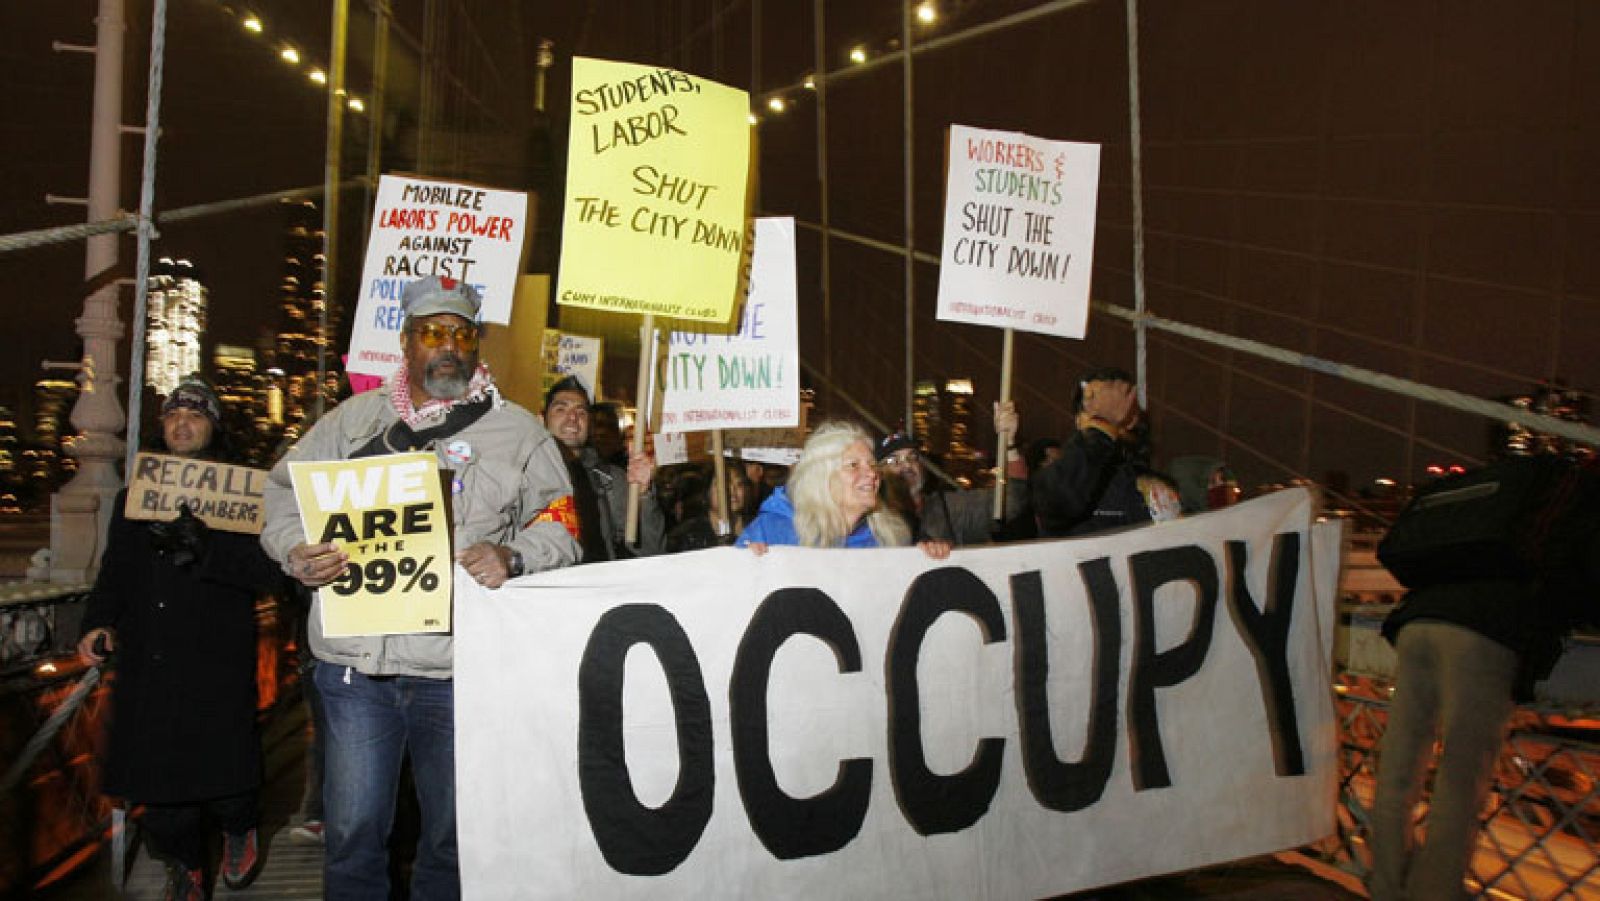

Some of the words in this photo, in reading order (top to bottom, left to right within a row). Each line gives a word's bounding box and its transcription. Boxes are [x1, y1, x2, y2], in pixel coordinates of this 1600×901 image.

[576, 69, 701, 115] STUDENTS,
[593, 104, 687, 154] LABOR
[968, 138, 1044, 171] WORKERS
[402, 184, 486, 211] MOBILIZE
[633, 164, 718, 209] SHUT
[975, 168, 1063, 205] STUDENTS
[379, 208, 440, 231] LABOR'S
[446, 212, 513, 242] POWER
[574, 197, 621, 227] THE
[631, 206, 688, 239] CITY
[692, 219, 743, 252] DOWN
[962, 202, 1013, 238] SHUT
[1025, 212, 1054, 244] THE
[399, 236, 473, 256] AGAINST
[954, 238, 999, 268] CITY
[1008, 246, 1071, 283] DOWN!
[383, 255, 476, 283] RACIST
[562, 290, 597, 303] CUNY
[685, 308, 717, 317] CLUBS
[657, 352, 706, 391] CITY
[718, 354, 784, 390] DOWN!
[137, 455, 263, 497] RECALL
[311, 460, 429, 512] WE
[141, 490, 259, 524] BLOOMBERG
[320, 502, 434, 544] ARE
[358, 540, 405, 554] THE
[331, 556, 439, 597] 99%
[578, 530, 1306, 877] OCCUPY
